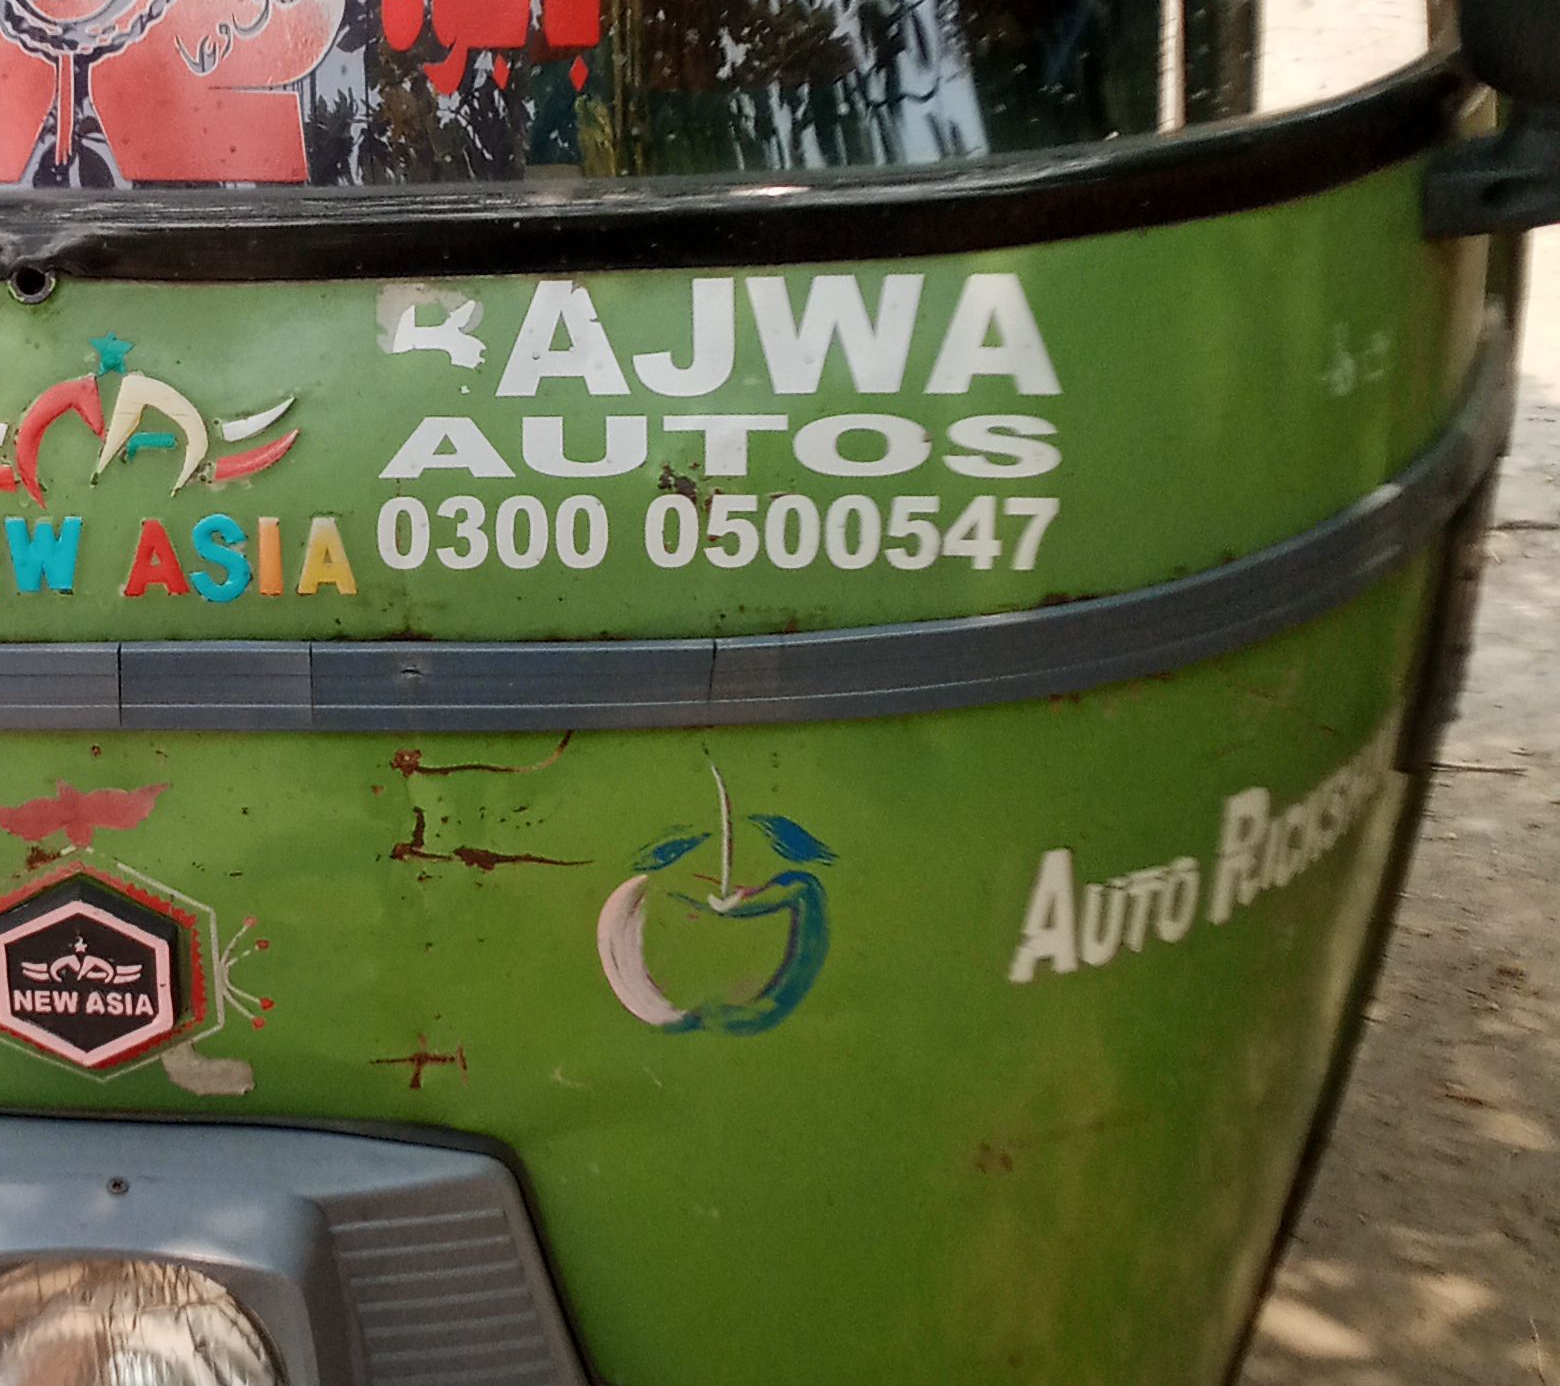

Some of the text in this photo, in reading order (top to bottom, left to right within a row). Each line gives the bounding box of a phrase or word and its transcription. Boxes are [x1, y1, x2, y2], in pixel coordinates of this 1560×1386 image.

[377, 413, 1063, 480] AUTOS
[122, 513, 358, 603] ASIA
[377, 493, 1061, 571] 0300 0500547
[13, 989, 154, 1017] NEW ASIA
